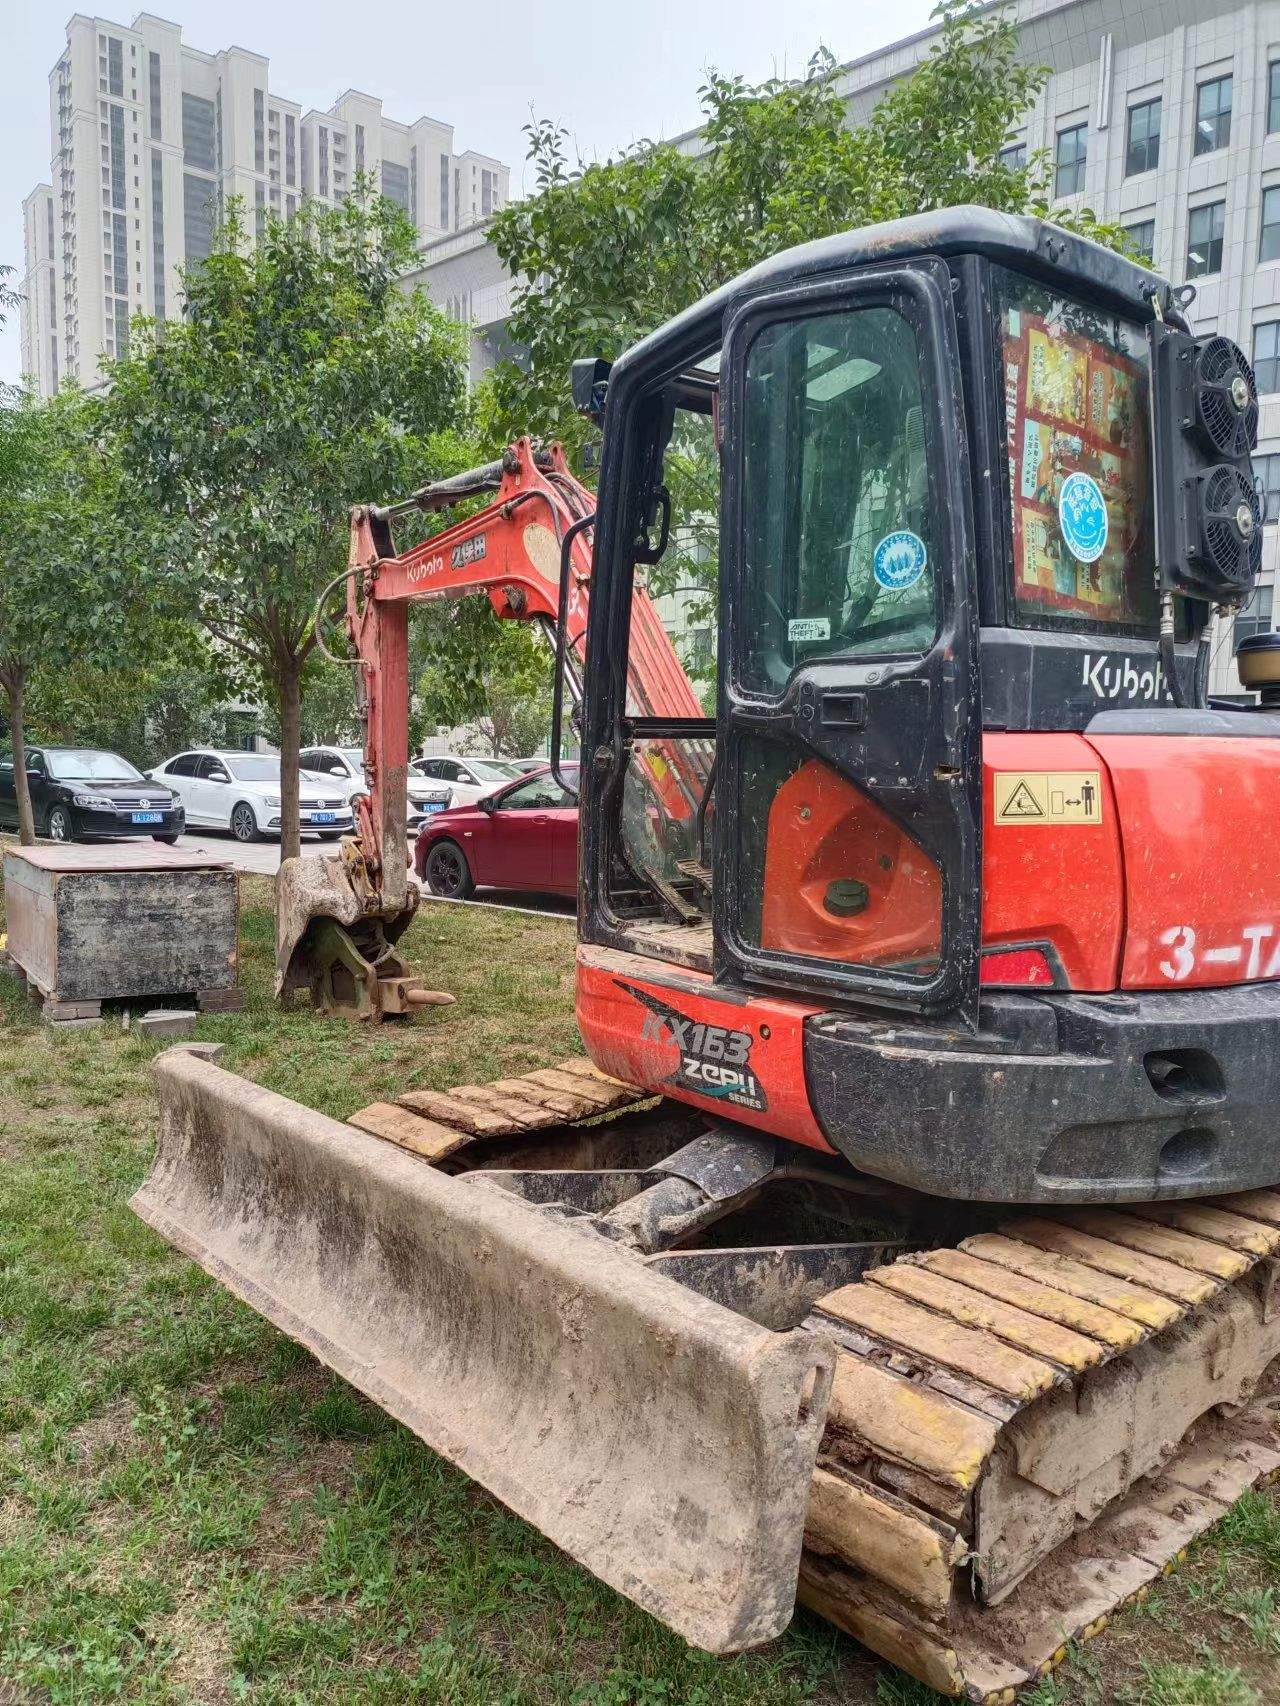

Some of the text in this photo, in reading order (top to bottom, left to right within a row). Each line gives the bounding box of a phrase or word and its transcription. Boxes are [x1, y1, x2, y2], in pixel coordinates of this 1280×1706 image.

[407, 555, 443, 582] Kubota
[640, 1009, 753, 1066] KX163
[728, 1092, 762, 1110] SERIES
